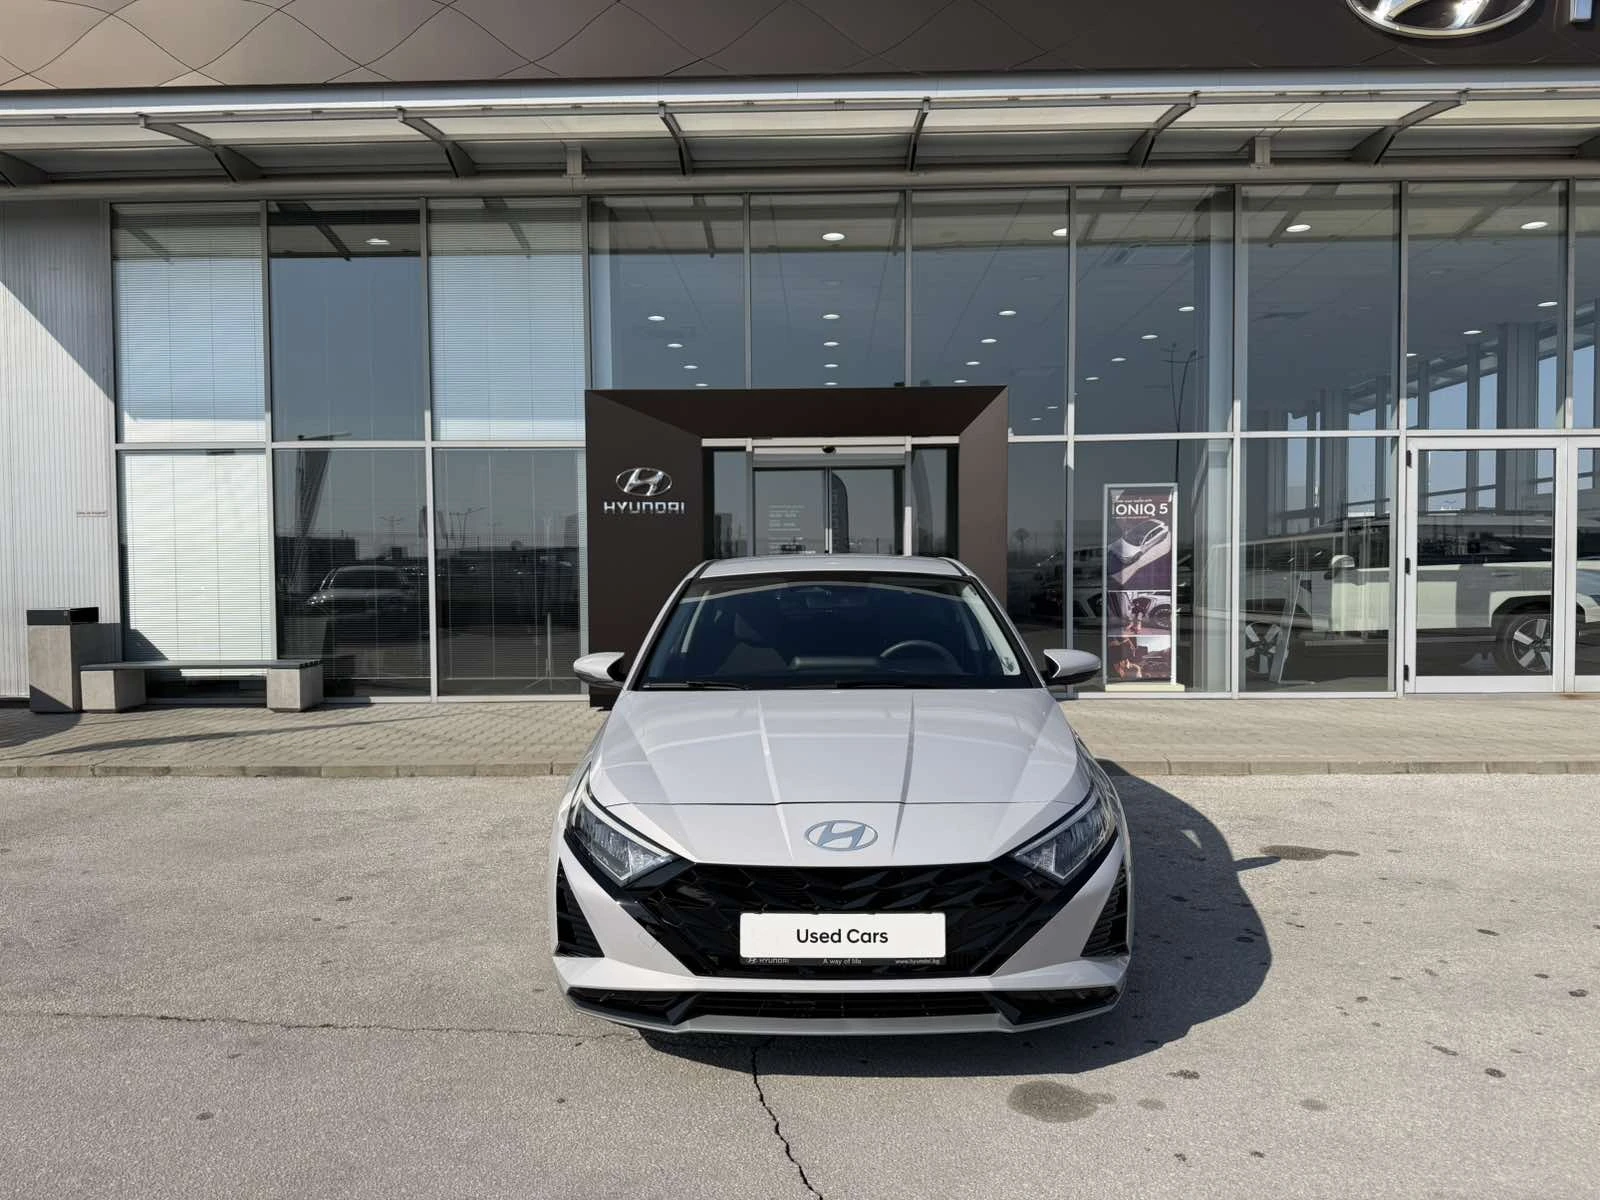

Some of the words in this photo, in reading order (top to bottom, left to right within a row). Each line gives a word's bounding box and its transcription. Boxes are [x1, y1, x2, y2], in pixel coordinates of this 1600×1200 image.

[604, 502, 685, 514] HYUNDAI
[1159, 503, 1168, 515] 5
[796, 928, 842, 944] Used
[846, 928, 889, 944] Cars
